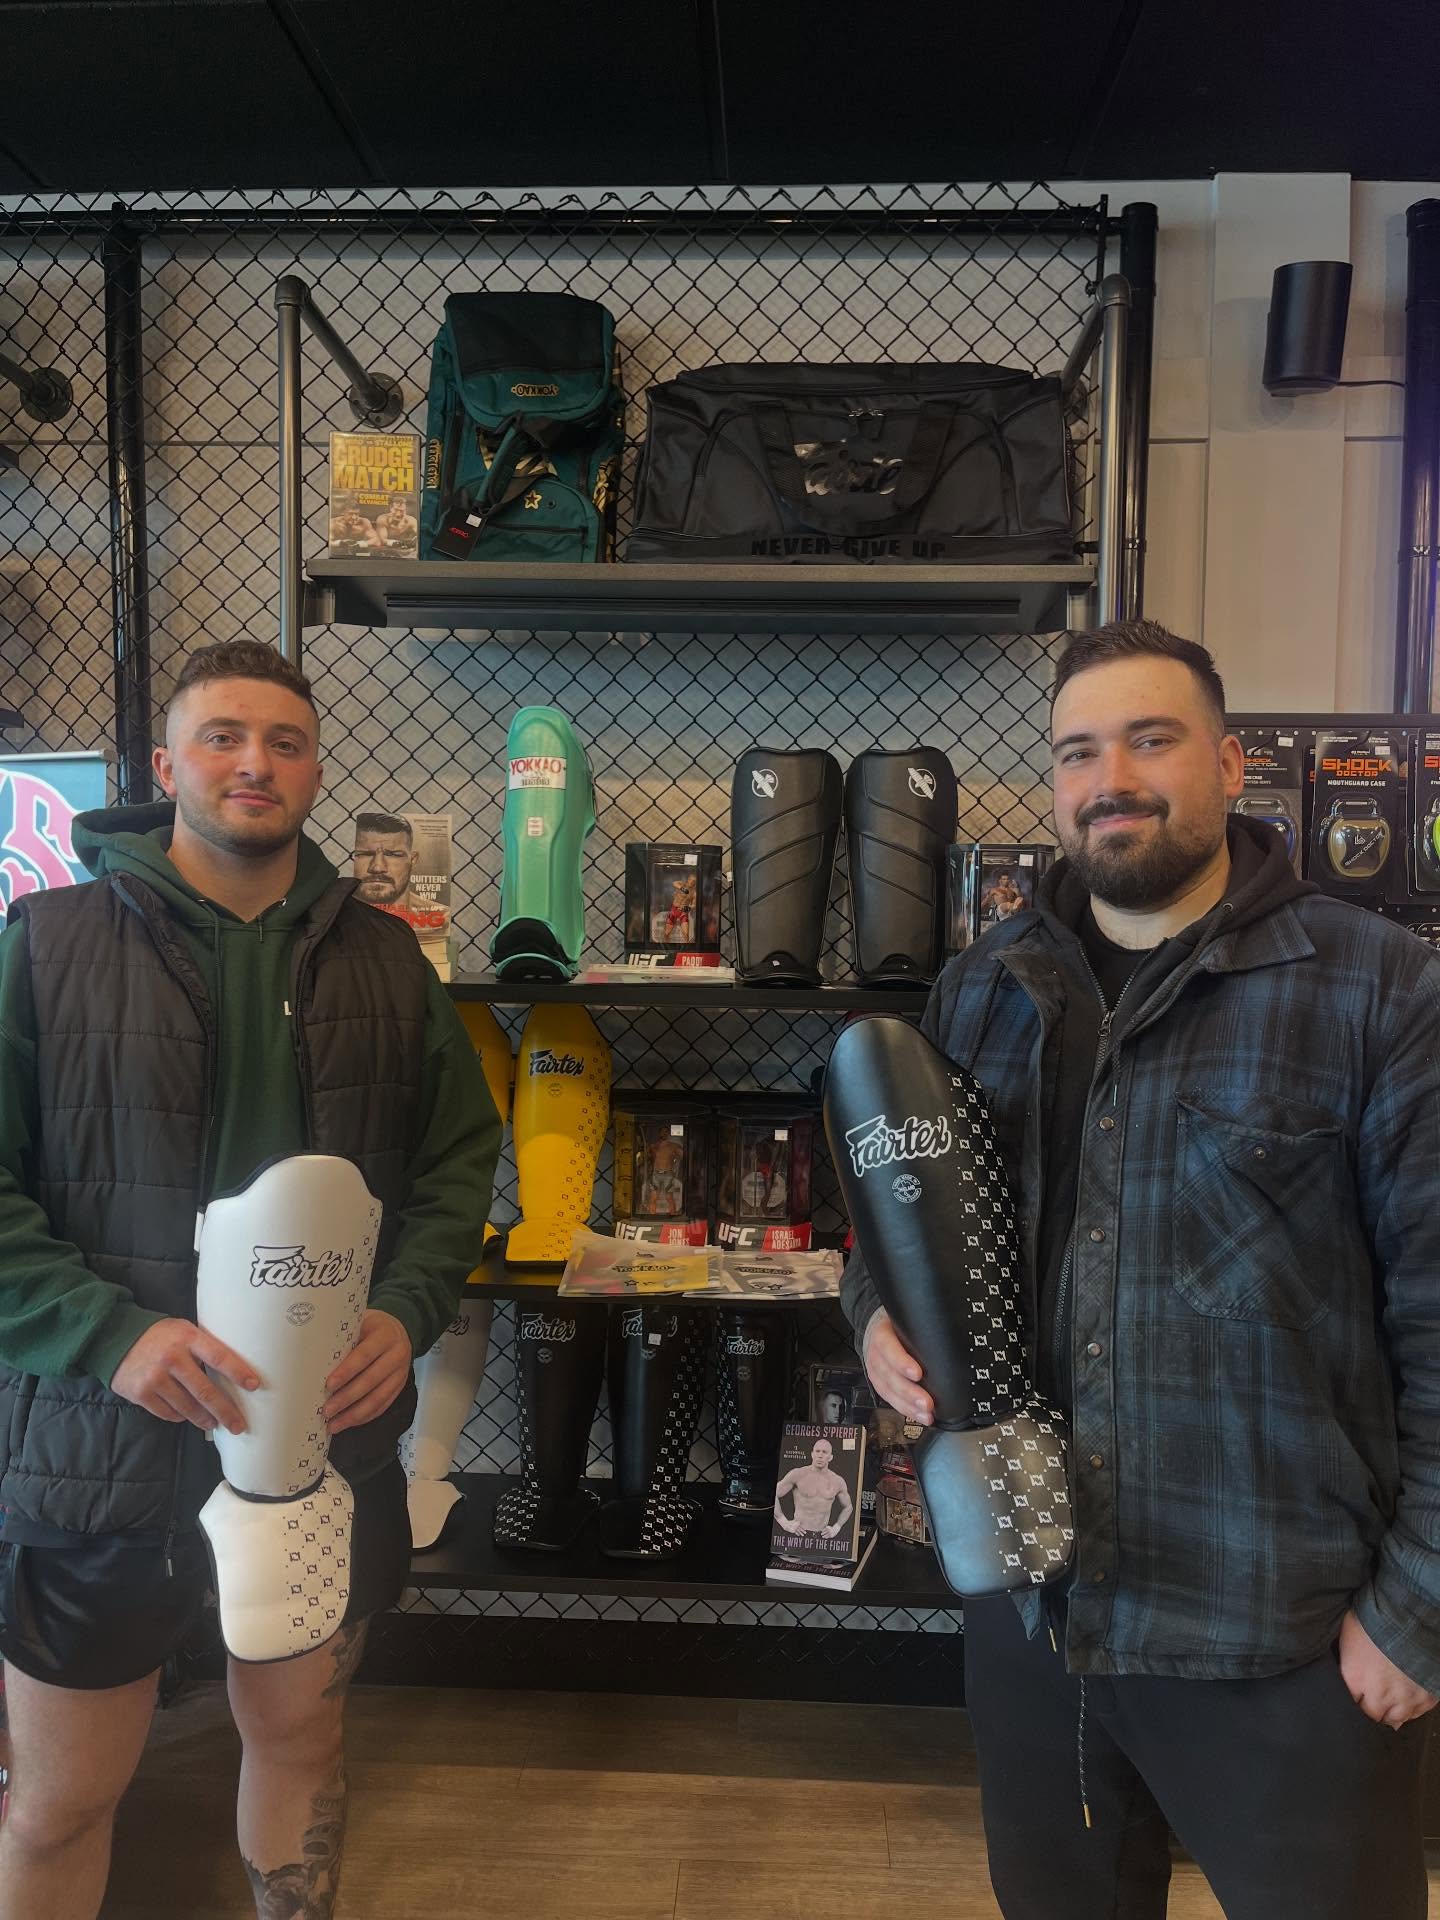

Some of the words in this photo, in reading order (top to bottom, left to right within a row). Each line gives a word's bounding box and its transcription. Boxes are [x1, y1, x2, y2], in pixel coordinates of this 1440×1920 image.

[333, 445, 413, 468] GRUDGE
[334, 465, 414, 491] MATCH
[752, 537, 831, 556] NEVER
[844, 538, 900, 559] GIVE
[912, 539, 946, 560] UP
[511, 758, 562, 775] YOKKAO
[1322, 758, 1392, 772] SHOCK
[1344, 850, 1364, 866] SHOCK
[1363, 831, 1385, 852] DOCTOR
[410, 875, 447, 883] QUITTERS
[416, 884, 441, 892] NEVER
[420, 892, 437, 900] WIN
[629, 953, 666, 968] UFC
[529, 1049, 585, 1077] Fairtex
[846, 1115, 951, 1177] Fairtex
[615, 1221, 652, 1240] UFC
[668, 1229, 683, 1238] JON
[719, 1222, 756, 1246] UFC
[772, 1229, 794, 1240] ISRAEL
[669, 1238, 690, 1246] JONES
[250, 1246, 354, 1287] Fairtex
[522, 1313, 576, 1341] Fairtex
[727, 1336, 765, 1356] Fairtex
[785, 1424, 820, 1437] GEORGES
[773, 1536, 785, 1547] THE
[787, 1537, 803, 1549] WAY
[804, 1539, 813, 1549] OF
[815, 1540, 828, 1551] THE
[829, 1541, 850, 1552] FIGHT
